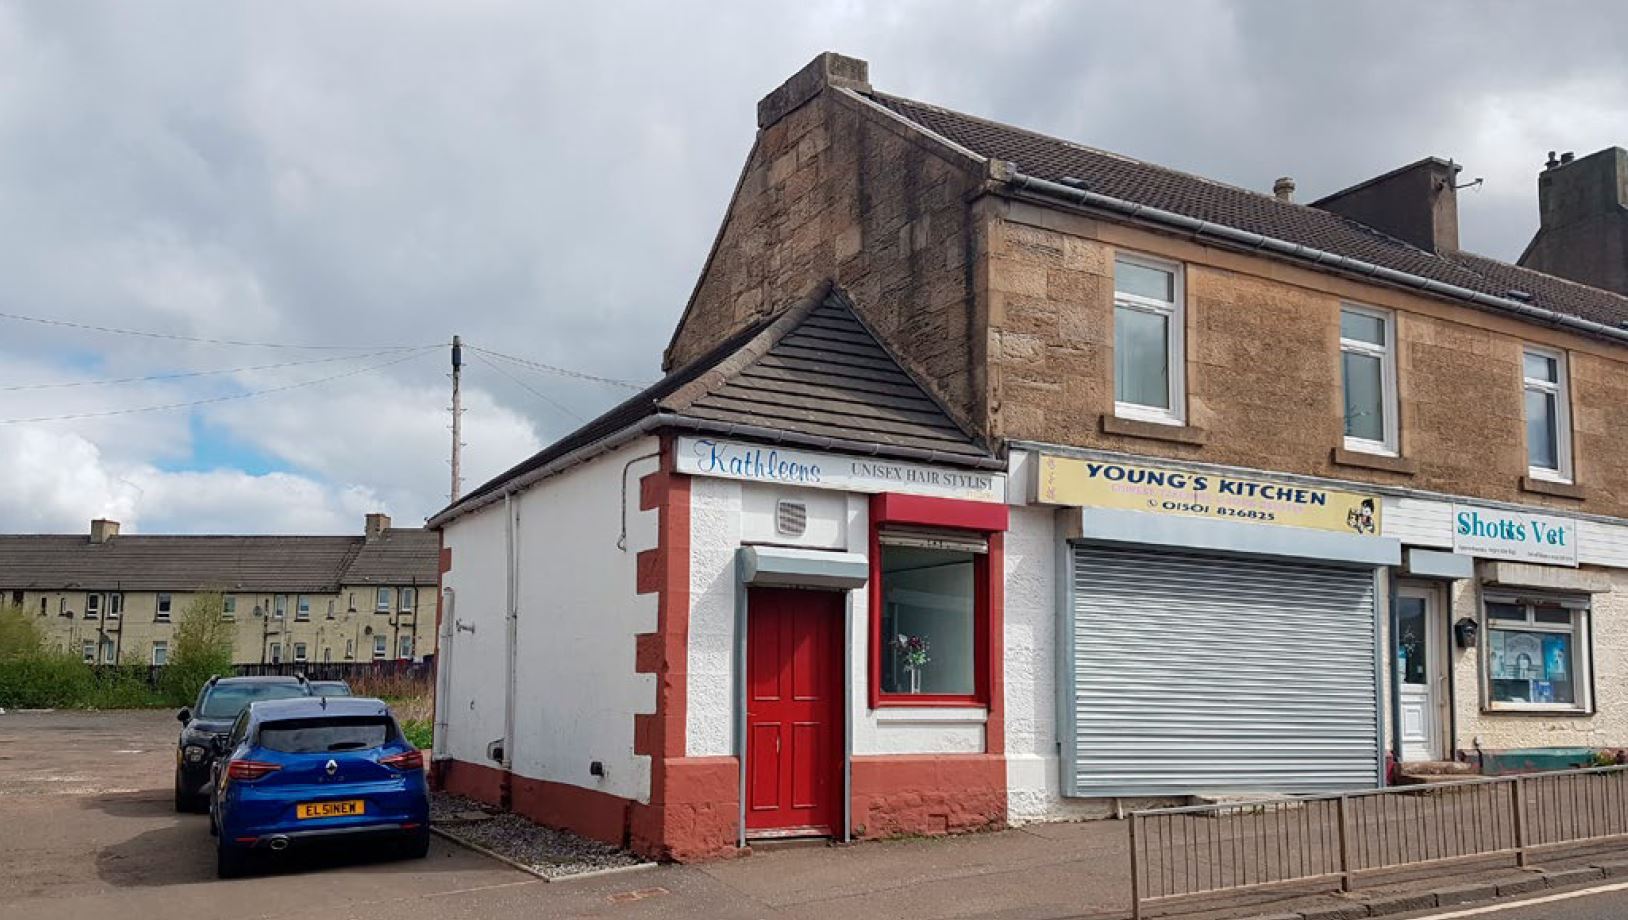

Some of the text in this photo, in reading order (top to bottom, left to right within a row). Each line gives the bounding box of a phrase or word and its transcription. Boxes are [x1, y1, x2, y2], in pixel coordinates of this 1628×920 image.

[694, 439, 821, 482] Kathleens
[851, 462, 993, 491] UNISEX HAIR STYLIST
[1086, 463, 1208, 491] YOUNG'S
[1219, 479, 1327, 506] KITCHEN
[1217, 507, 1275, 521] 826825
[1457, 511, 1566, 546] Shotts Vet
